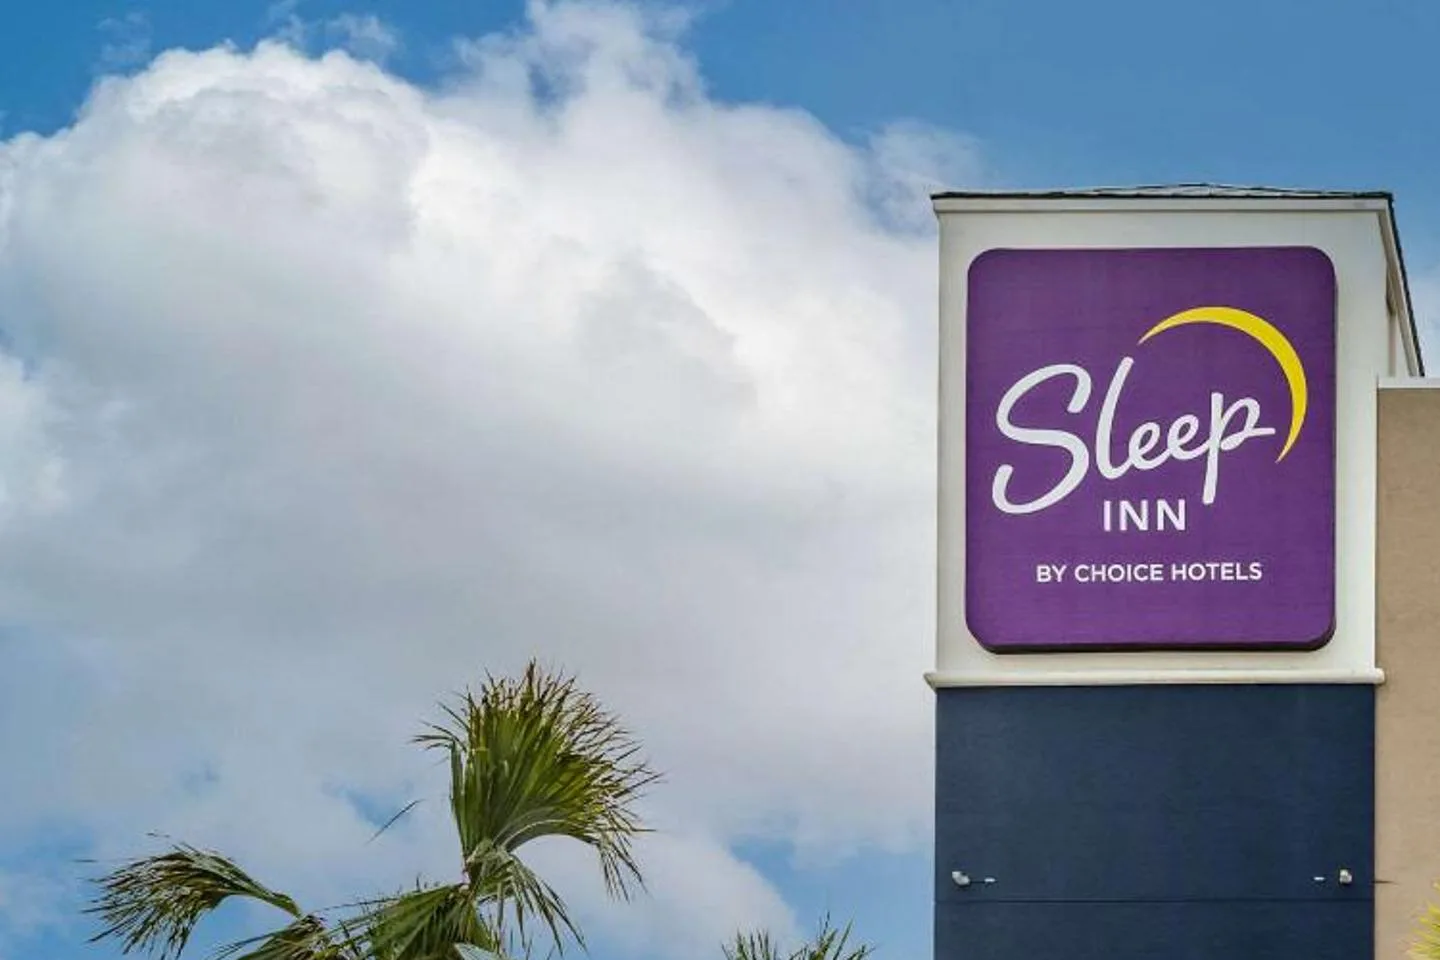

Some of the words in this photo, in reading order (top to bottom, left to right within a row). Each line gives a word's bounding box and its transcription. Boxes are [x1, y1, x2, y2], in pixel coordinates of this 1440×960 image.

[992, 356, 1276, 514] Sleep
[1103, 499, 1187, 532] INN
[1036, 565, 1067, 582] BY
[1074, 564, 1163, 583] CHOICE
[1171, 562, 1263, 582] HOTELS
